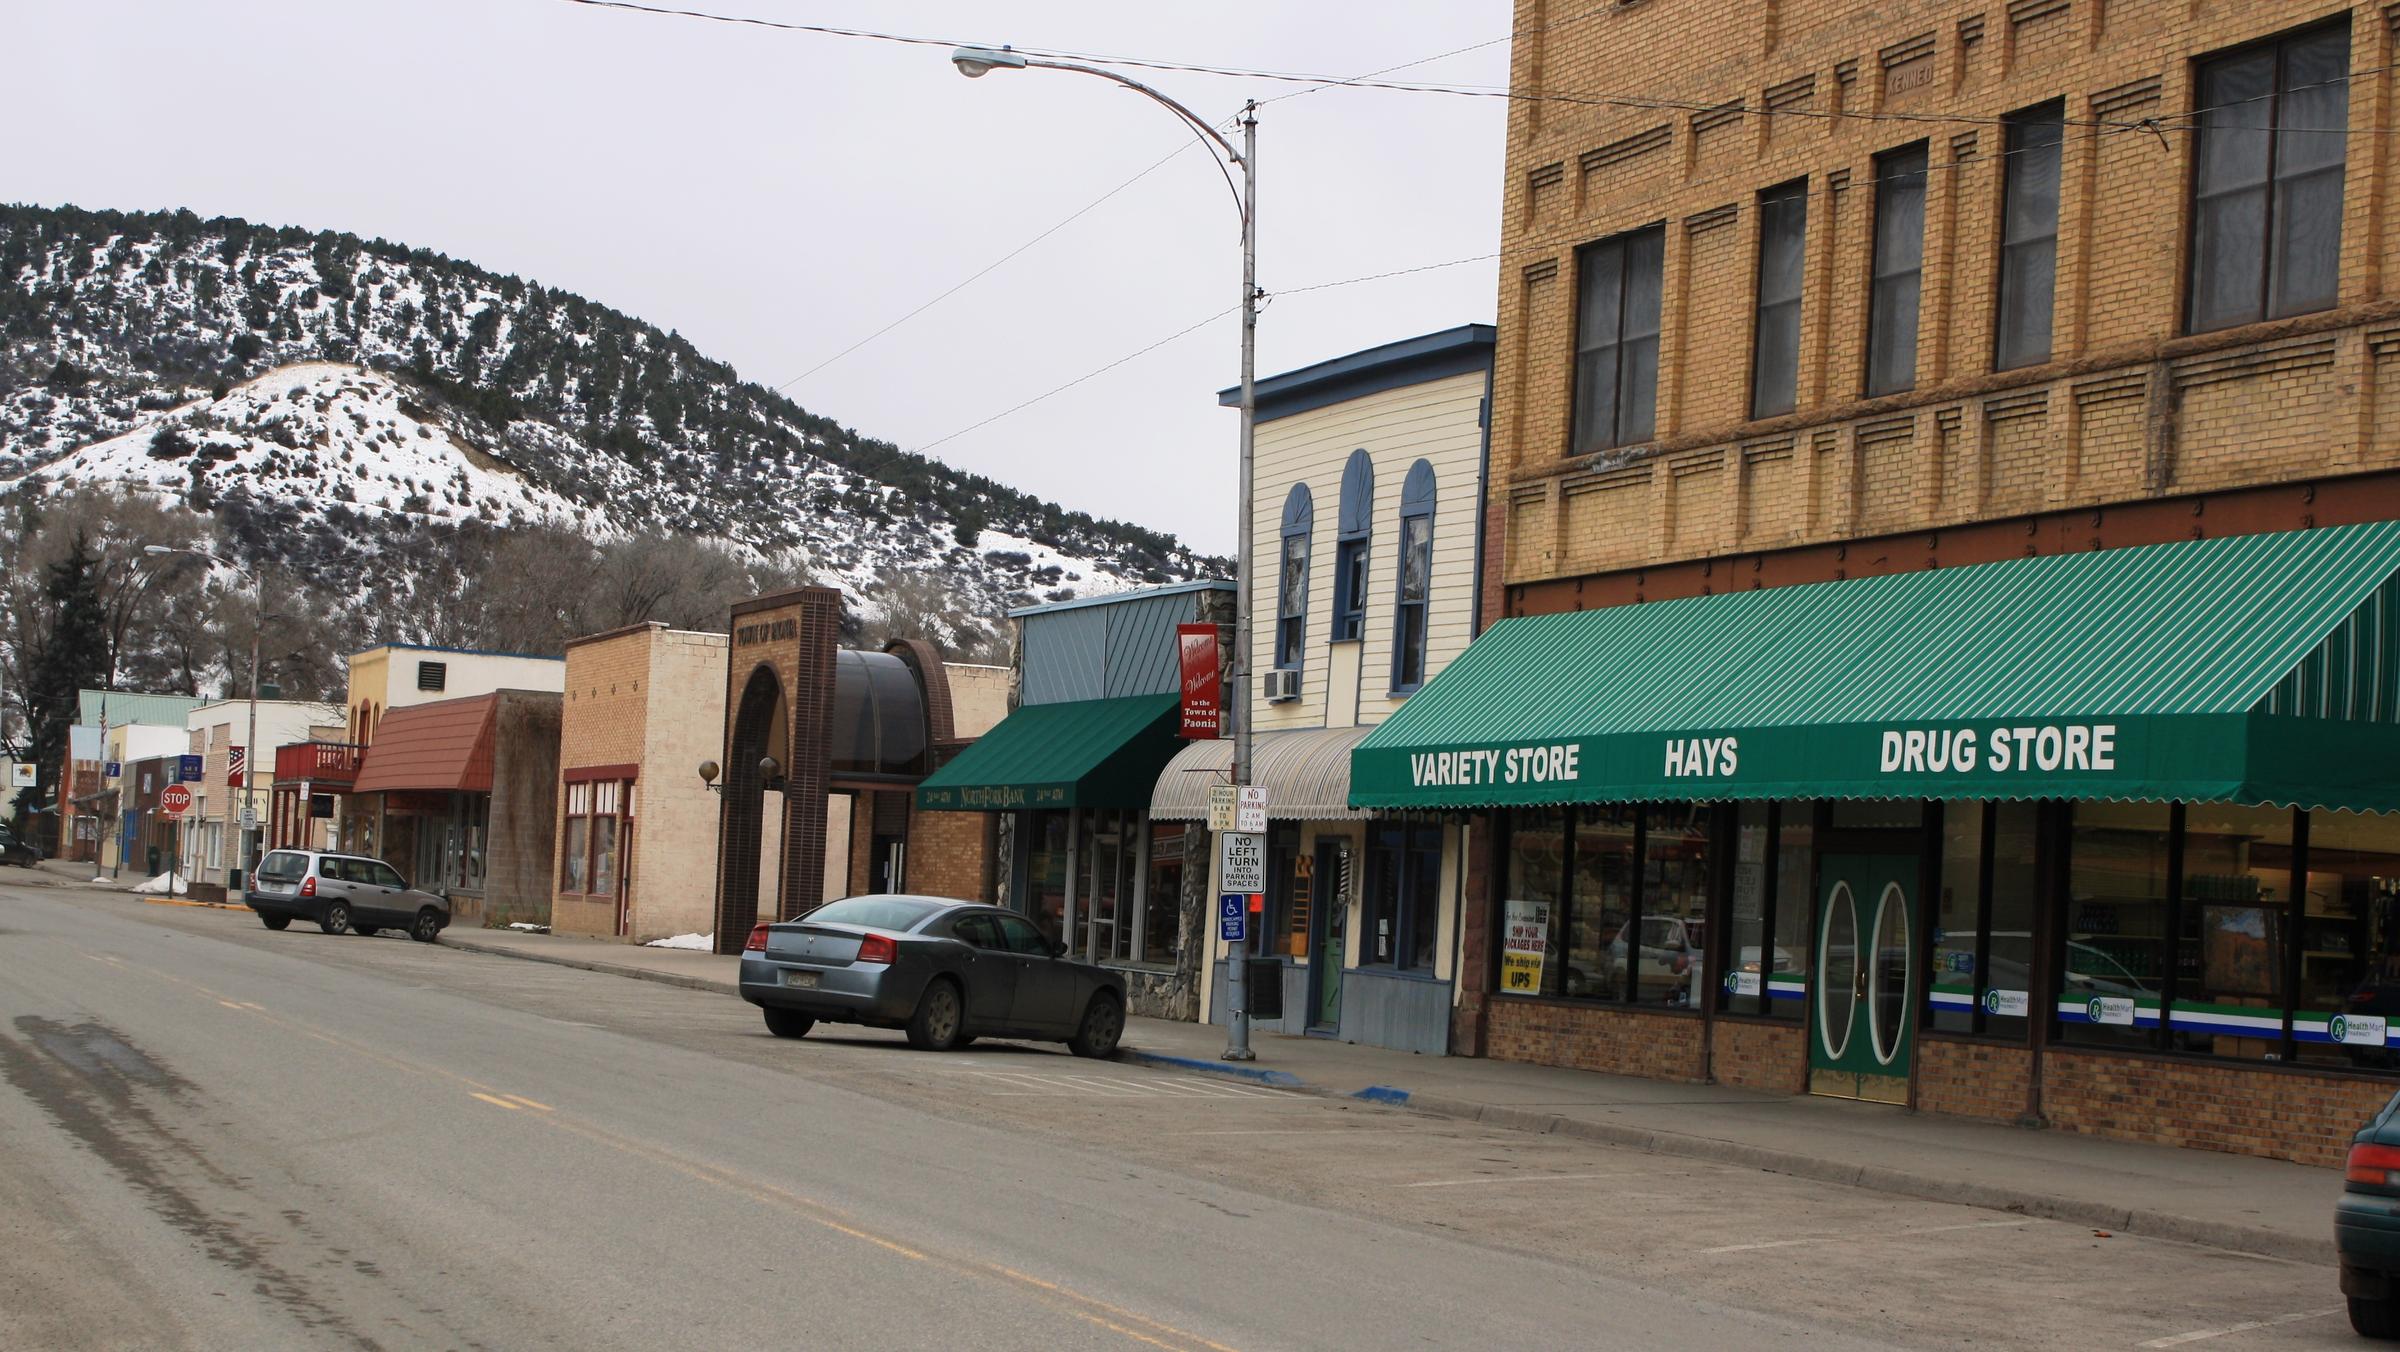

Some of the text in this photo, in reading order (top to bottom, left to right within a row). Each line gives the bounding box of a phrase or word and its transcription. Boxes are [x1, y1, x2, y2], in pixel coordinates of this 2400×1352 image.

[1185, 669, 1215, 694] Welcome
[1184, 708, 1216, 716] Town of
[1184, 718, 1217, 728] Paonia
[1880, 725, 2116, 773] DRUG STORE
[1664, 736, 1738, 777] HAYS
[1410, 743, 1580, 787] VARIETY STORE
[164, 793, 189, 805] STOP
[1247, 790, 1259, 800] NO
[1240, 801, 1266, 811] PARKING
[1235, 836, 1252, 846] NO
[1229, 847, 1257, 856] LEFT
[1228, 857, 1259, 866] TURN
[1512, 925, 1539, 938] SHIP YOUR
[1504, 938, 1545, 952] PACKAGES HERE
[1504, 955, 1514, 966] We
[1516, 956, 1529, 970] ship
[1511, 971, 1531, 988] UPS
[2347, 1020, 2369, 1031] Health
[2369, 1022, 2384, 1032] Mart
